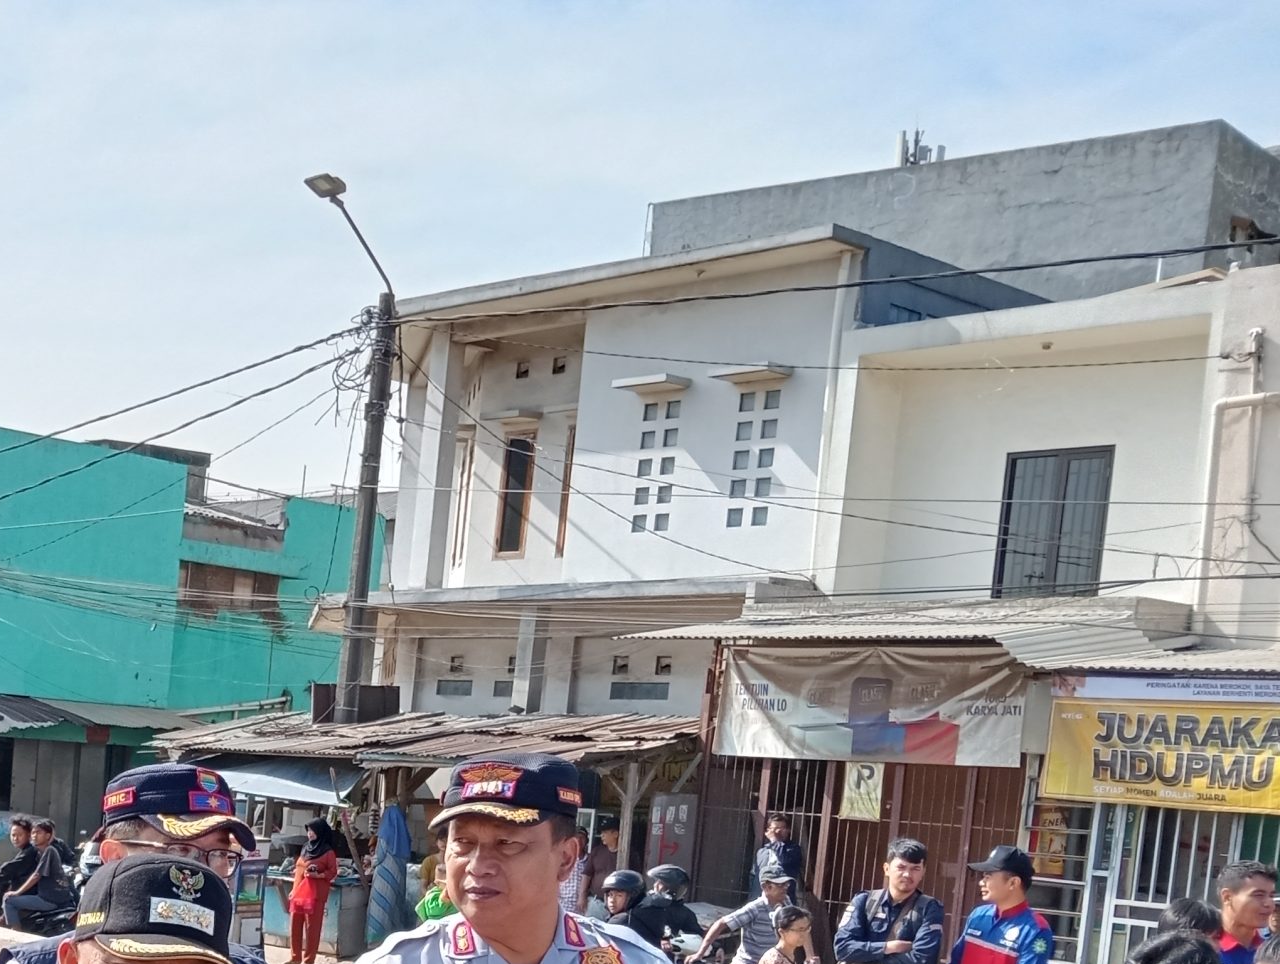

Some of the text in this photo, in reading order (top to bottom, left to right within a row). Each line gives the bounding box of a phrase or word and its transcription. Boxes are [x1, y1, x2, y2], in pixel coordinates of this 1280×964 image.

[777, 699, 787, 712] LO
[966, 705, 1022, 717] KARYA JATI
[1092, 748, 1275, 791] HIDUPMU
[1093, 785, 1124, 795] SETIAP
[1159, 790, 1194, 800] ADALAH
[1196, 793, 1227, 802] JUARA
